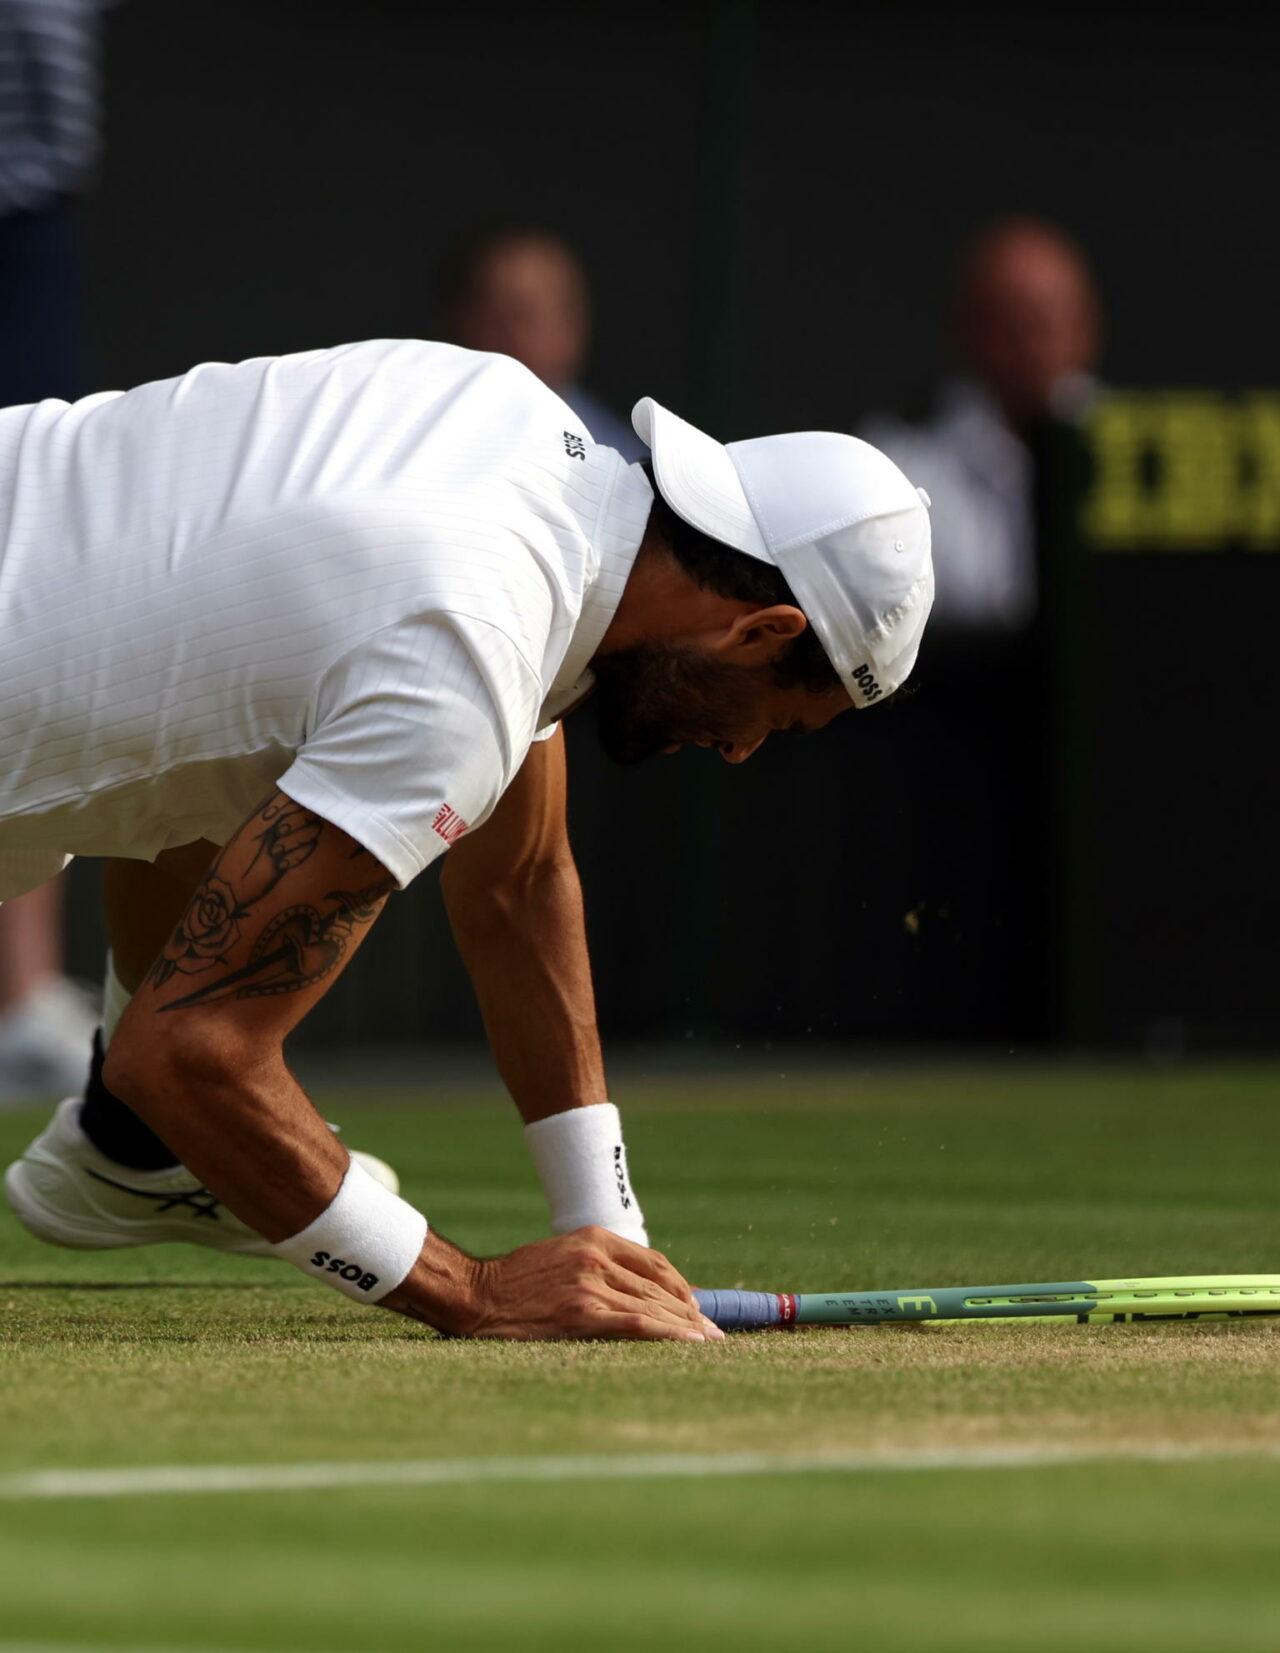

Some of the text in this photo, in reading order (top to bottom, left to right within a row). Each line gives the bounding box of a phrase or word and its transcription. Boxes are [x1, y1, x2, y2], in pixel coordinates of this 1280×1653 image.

[1090, 390, 1280, 546] IB
[851, 663, 883, 701] BOSS
[614, 1146, 631, 1210] BOSS
[310, 1251, 380, 1292] BOSS
